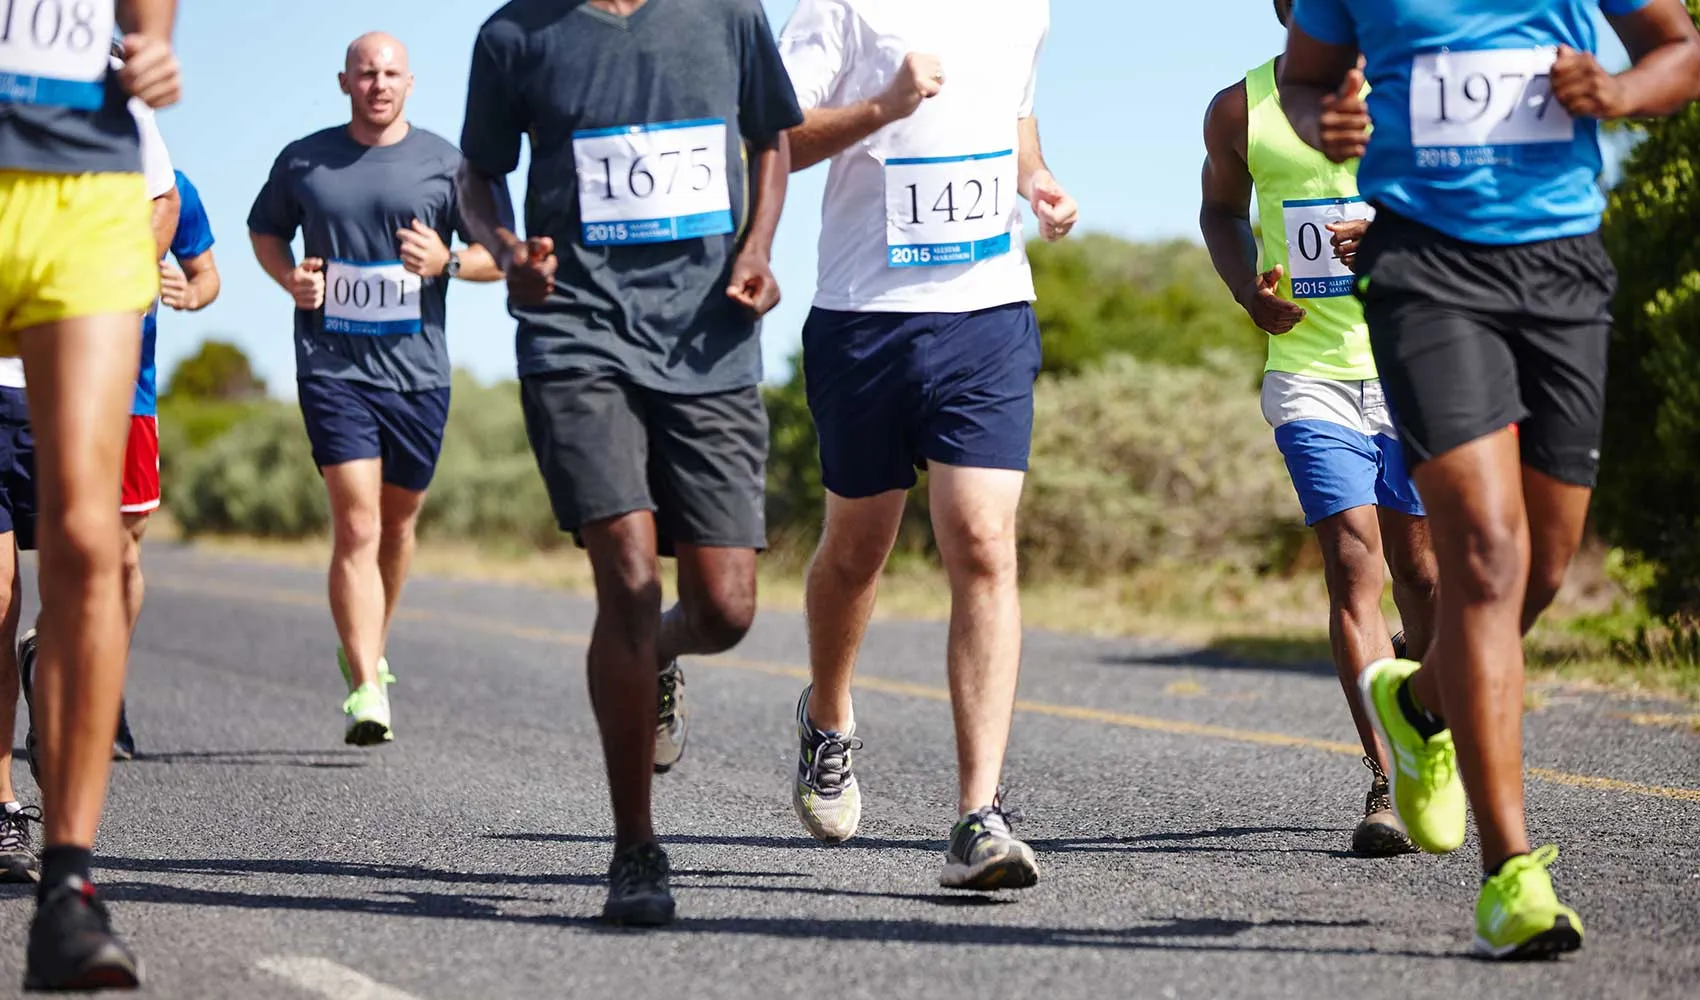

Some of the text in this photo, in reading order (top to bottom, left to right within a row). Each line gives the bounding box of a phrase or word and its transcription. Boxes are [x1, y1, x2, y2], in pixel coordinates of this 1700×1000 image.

[1432, 73, 1551, 124] 1977
[597, 147, 712, 200] 1675
[905, 176, 999, 225] 1421
[585, 224, 628, 241] 2015
[1298, 222, 1341, 261] 0
[891, 247, 932, 263] 2015
[334, 276, 407, 309] 0011
[1294, 281, 1327, 294] 2015
[326, 318, 350, 332] 2015
